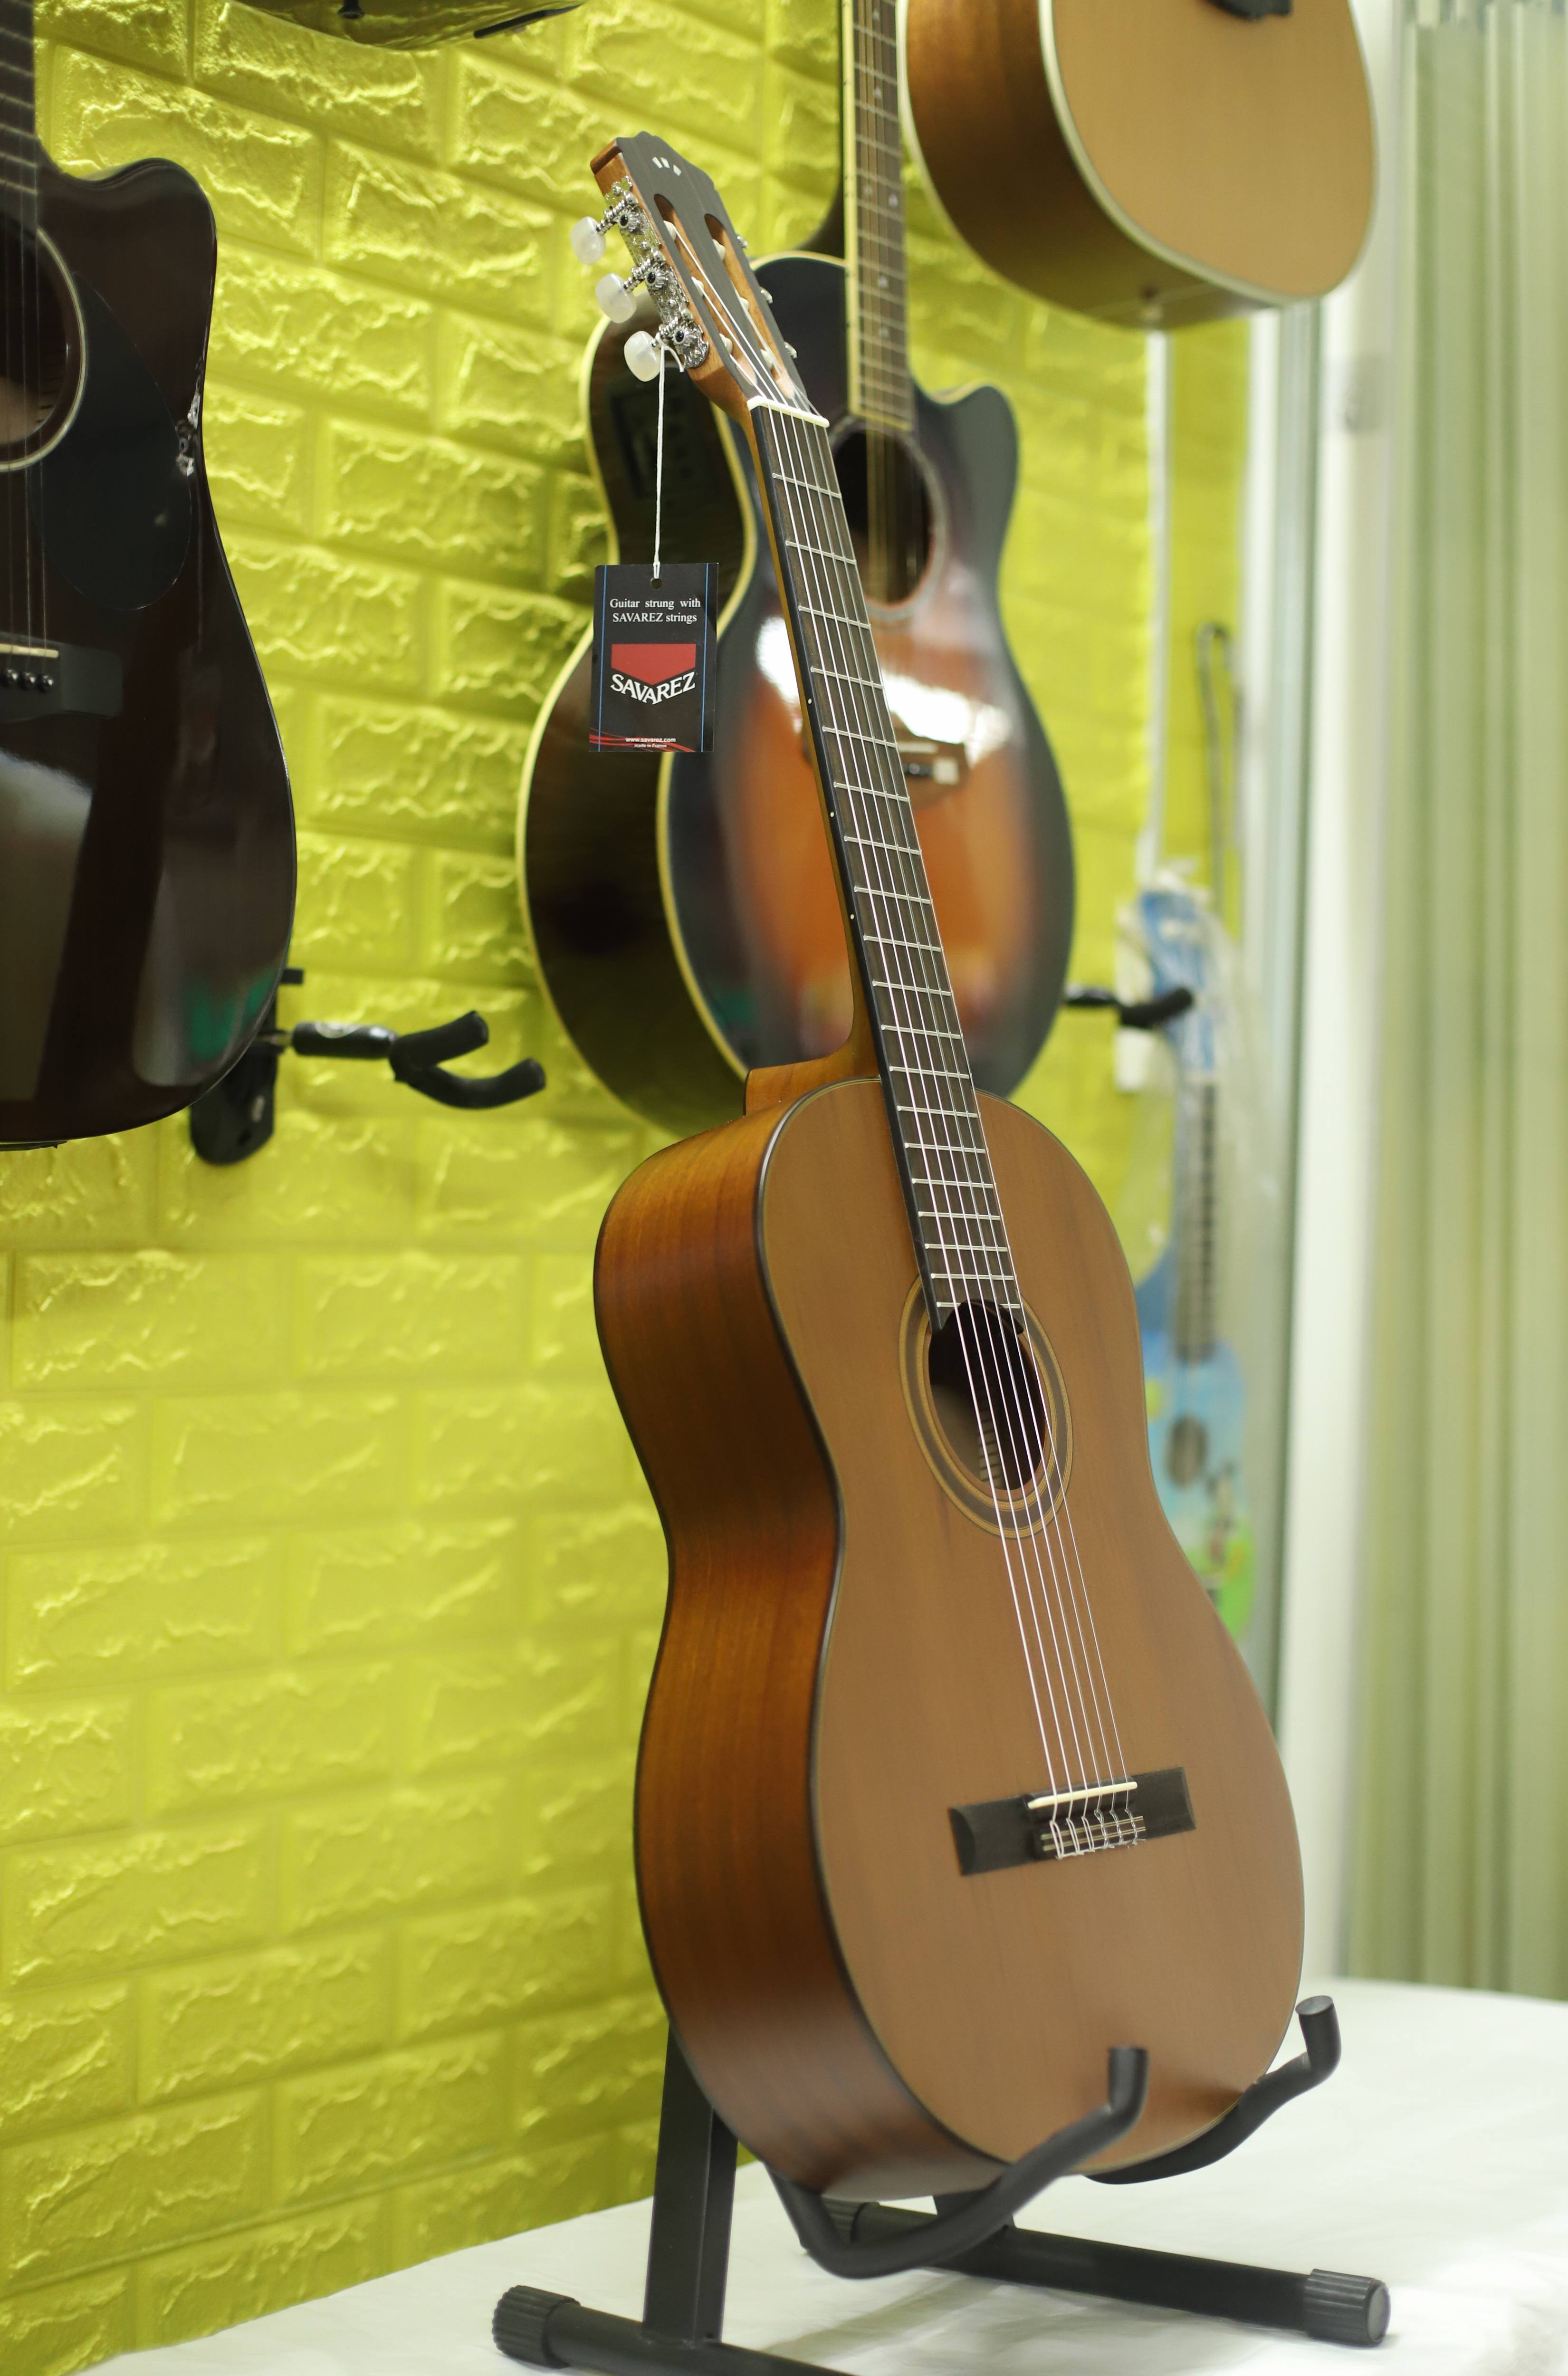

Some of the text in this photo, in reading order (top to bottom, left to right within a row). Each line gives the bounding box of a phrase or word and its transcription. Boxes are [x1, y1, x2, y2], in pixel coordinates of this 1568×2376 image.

[610, 598, 701, 610] Guitar strung with
[612, 613, 697, 624] SAVAREZ strings
[610, 671, 696, 705] SAVAREZ
